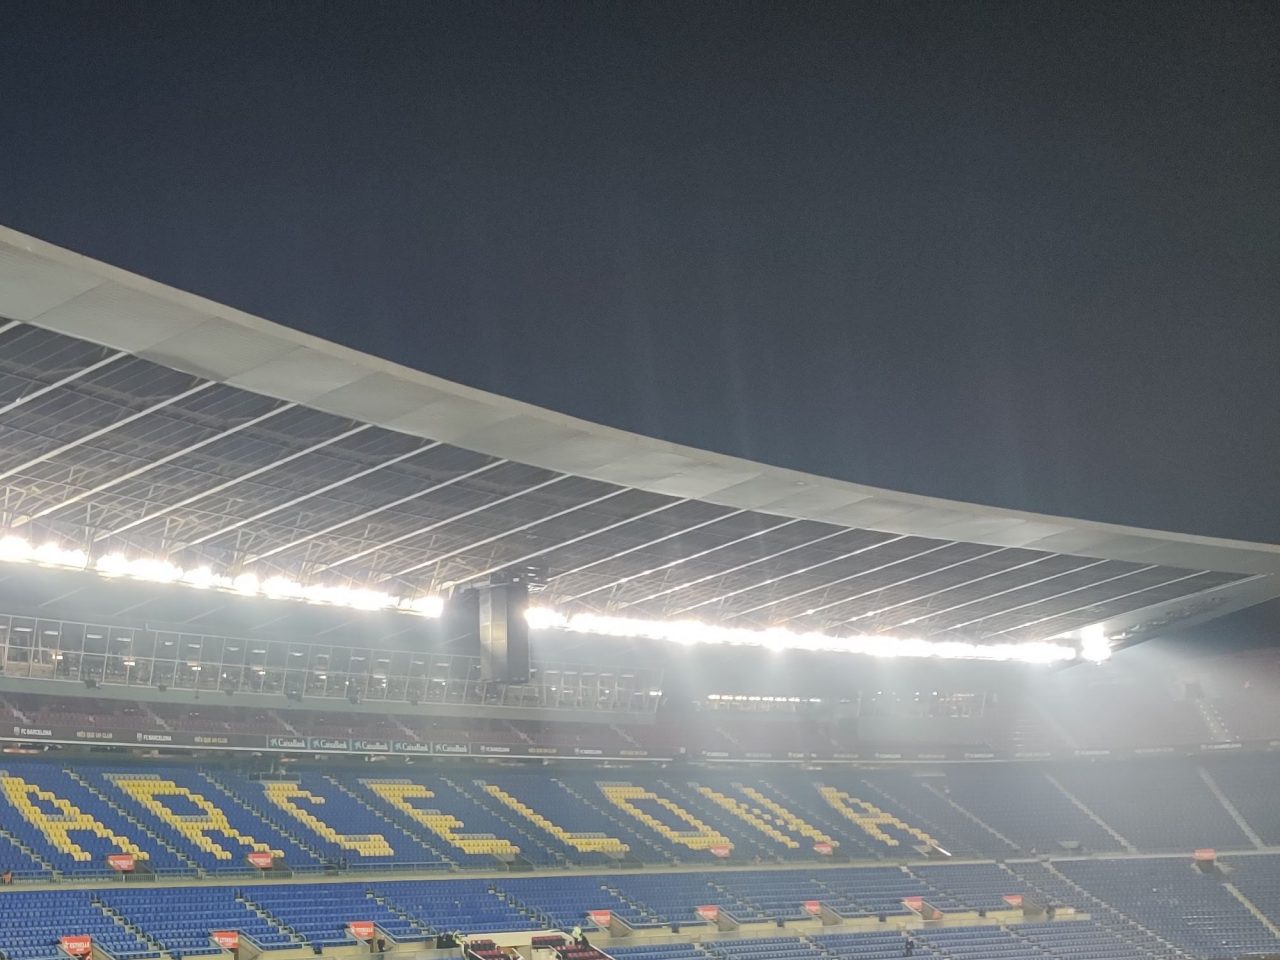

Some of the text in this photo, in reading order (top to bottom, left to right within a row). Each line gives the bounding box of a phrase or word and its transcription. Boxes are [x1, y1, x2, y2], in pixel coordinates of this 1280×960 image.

[278, 738, 305, 748] CaixaBank
[320, 740, 347, 748] CaixaBank
[361, 740, 388, 750] CaixaBank
[402, 742, 428, 751] CaixaBank
[442, 743, 468, 752] CaixaBank
